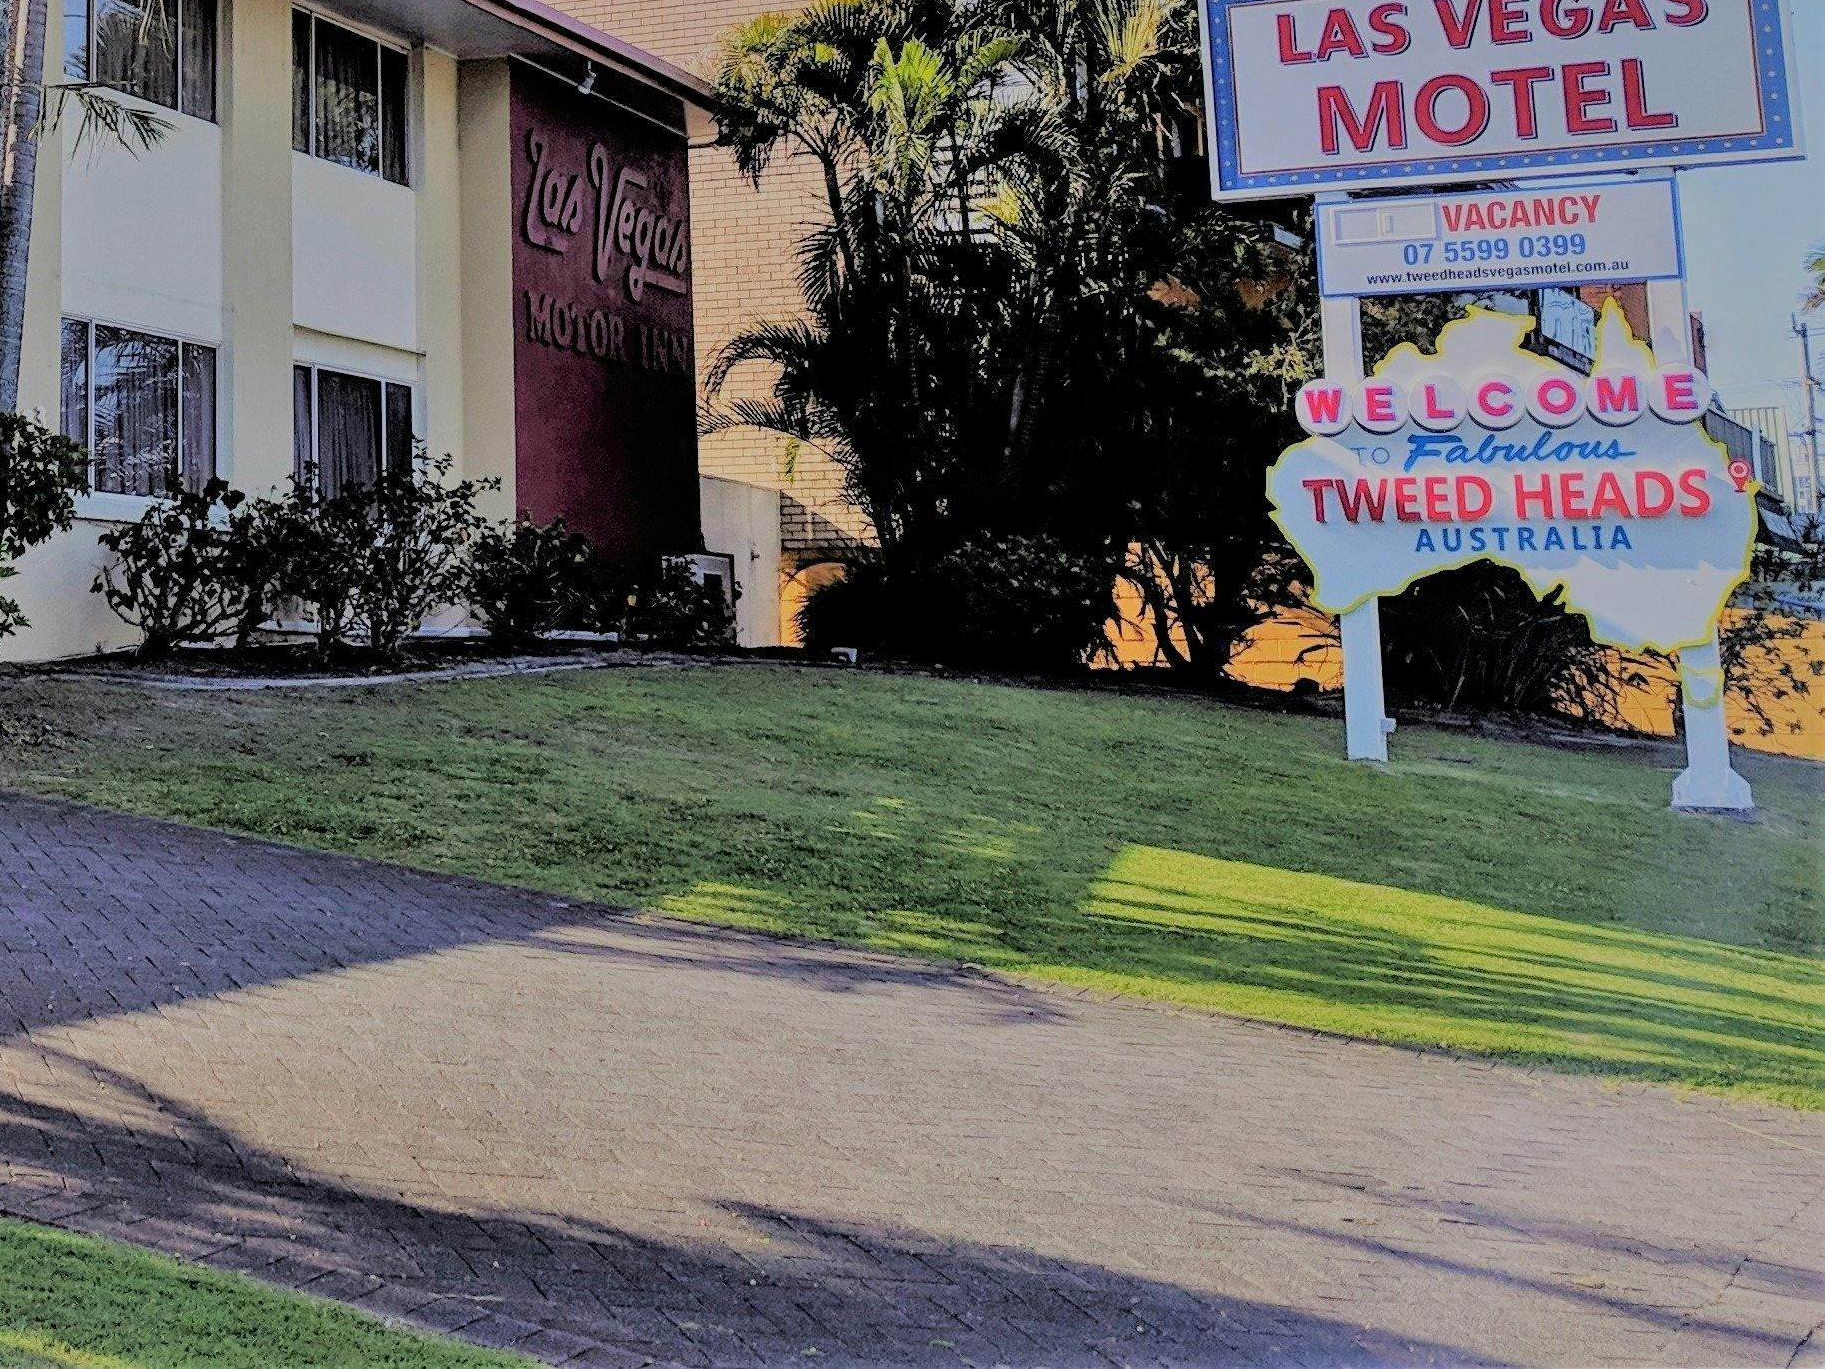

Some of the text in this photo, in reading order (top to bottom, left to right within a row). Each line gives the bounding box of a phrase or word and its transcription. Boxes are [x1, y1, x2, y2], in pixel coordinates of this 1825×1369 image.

[1277, 2, 1411, 65] LAS
[1316, 58, 1679, 156] MOTEL
[525, 128, 689, 302] Las Vegas
[1441, 194, 1602, 232] VACANCY
[1366, 259, 1630, 286] www.tweedheadsvegasmotel.com.au
[1402, 233, 1586, 266] 07 5599 0399
[526, 289, 625, 361] MOTOR
[1305, 373, 1700, 425] WELCOME
[1350, 431, 1637, 472] TO Fabulous
[1302, 468, 1711, 524] TWEED HEADS
[1414, 524, 1633, 553] AUSTRALIA
